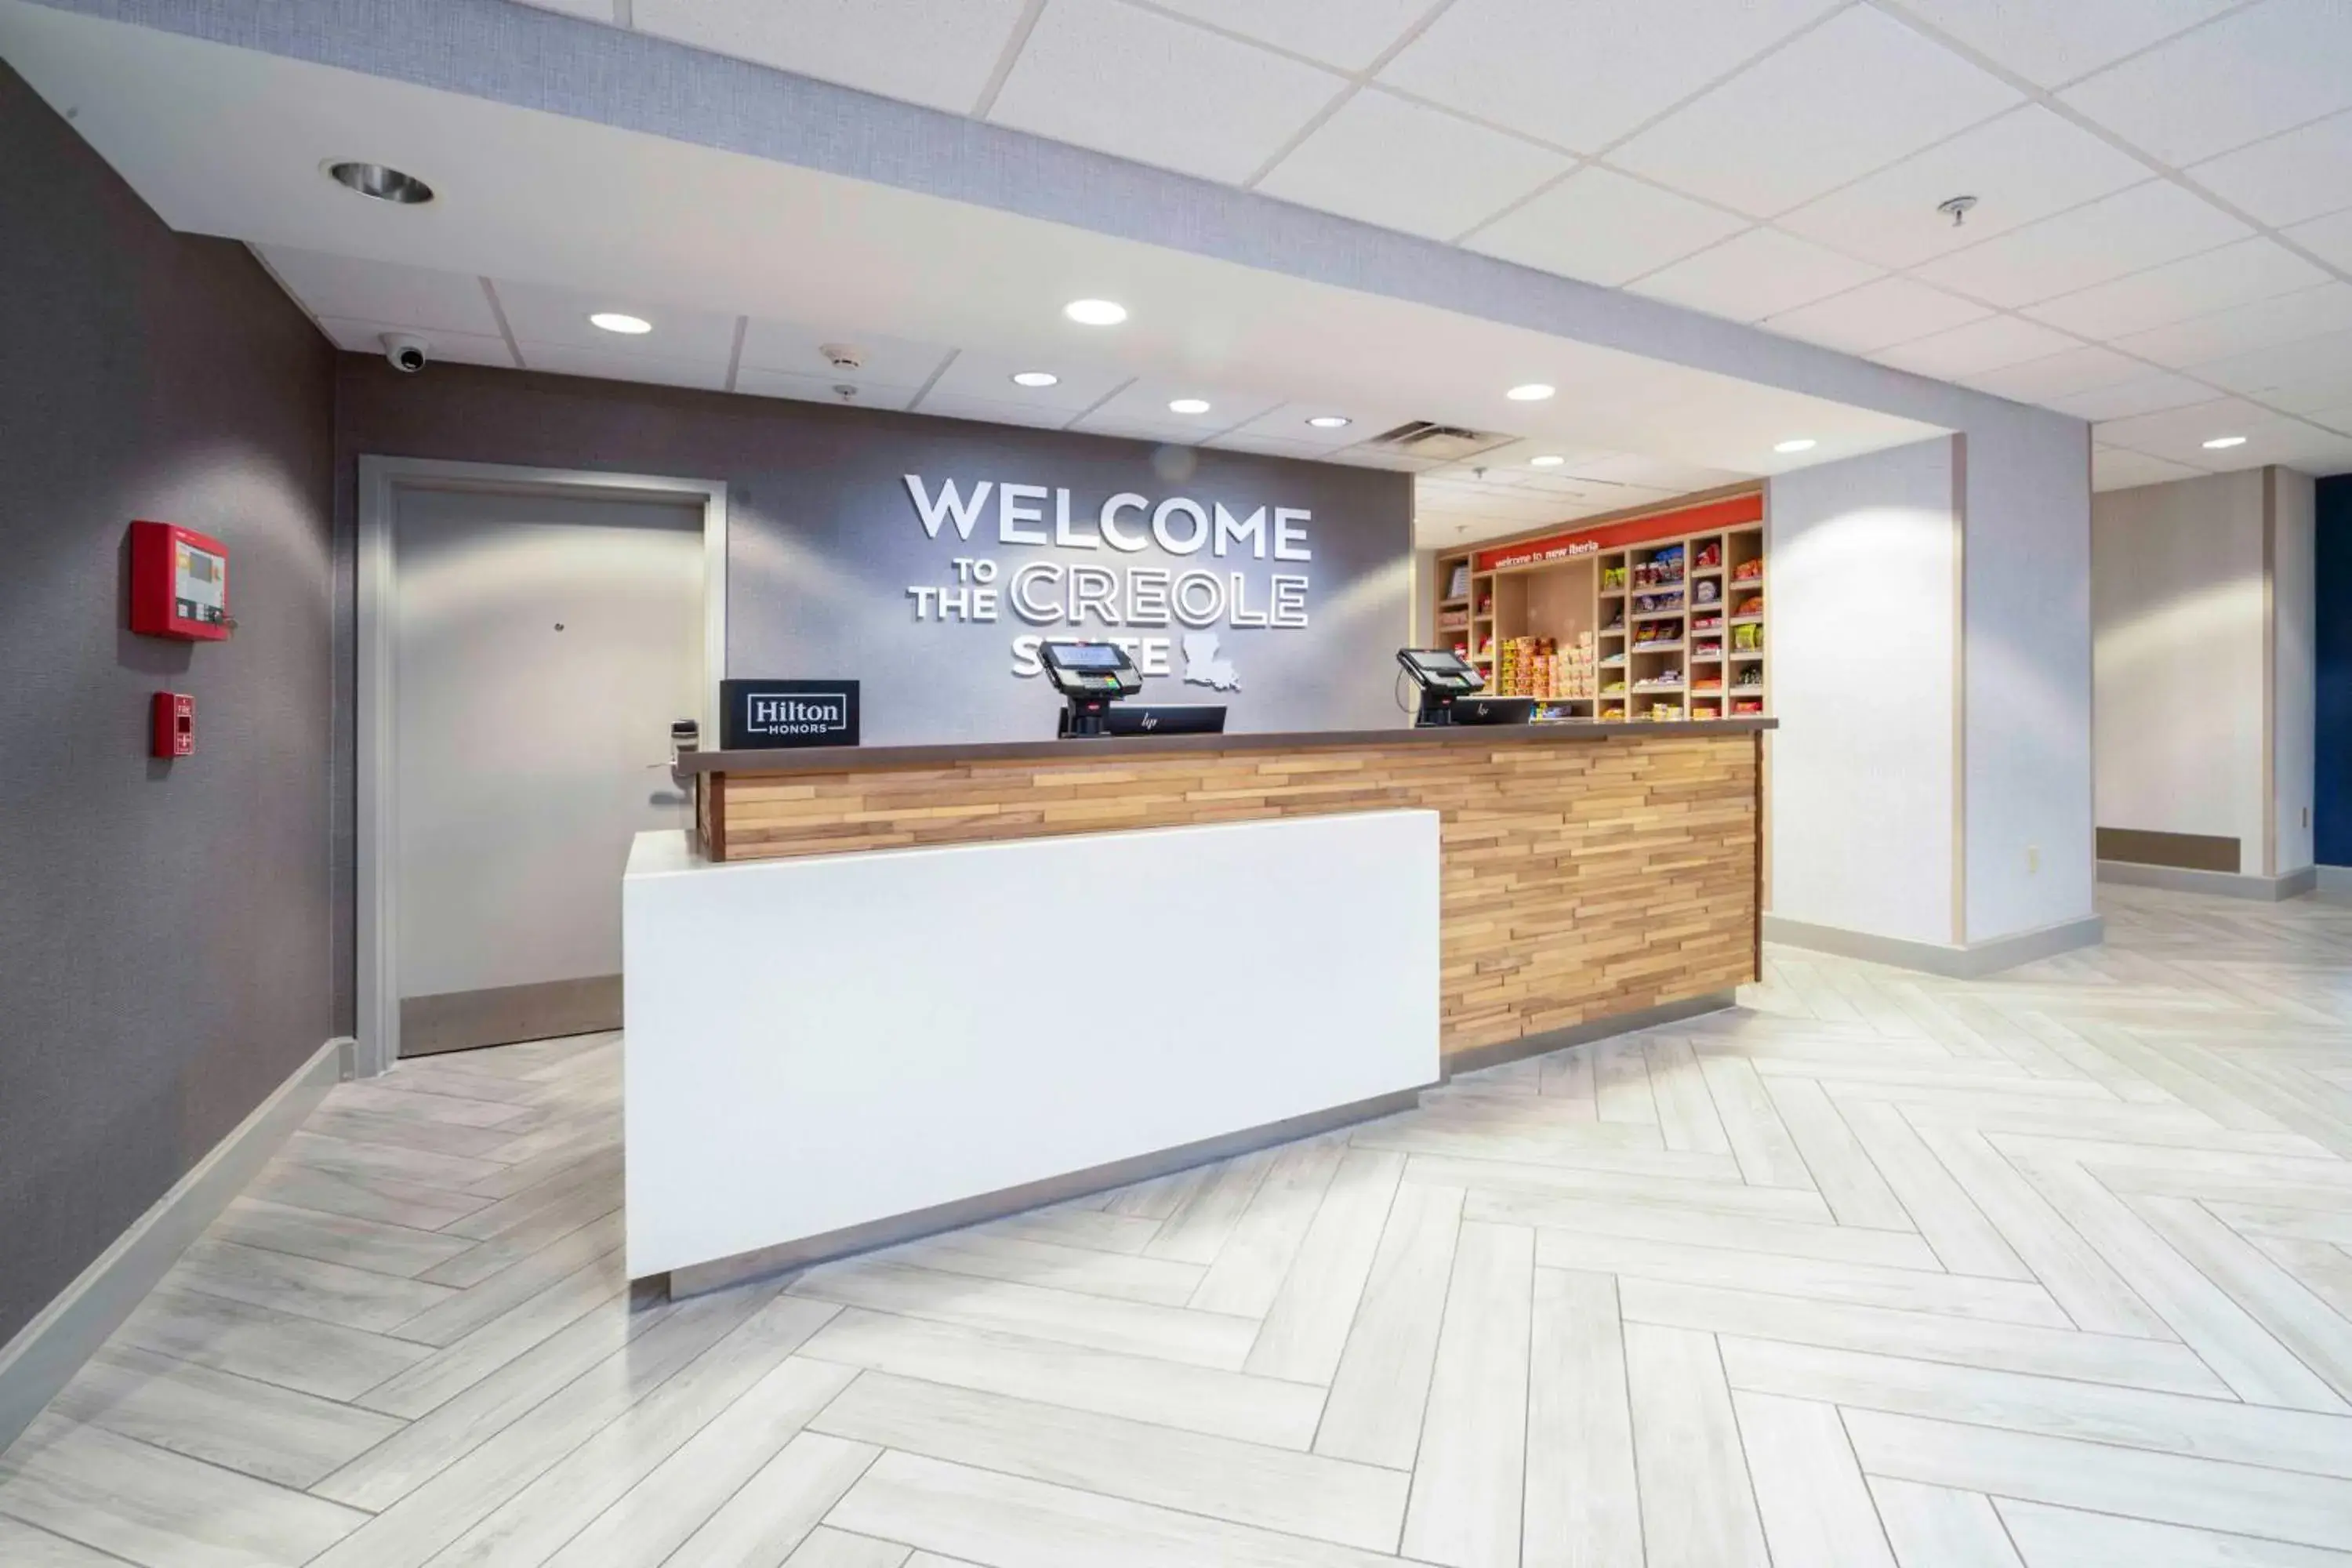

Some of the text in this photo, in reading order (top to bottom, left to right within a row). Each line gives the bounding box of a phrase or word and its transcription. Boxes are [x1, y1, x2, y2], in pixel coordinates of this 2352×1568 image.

[905, 474, 1312, 560] WELCOME
[1495, 554, 1531, 568] welcome
[1533, 551, 1542, 561] to
[1545, 548, 1567, 559] new
[952, 557, 997, 583] TO
[906, 561, 1308, 627] THE CREOLE
[756, 701, 838, 722] Hilton
[769, 724, 827, 735] HONORS
